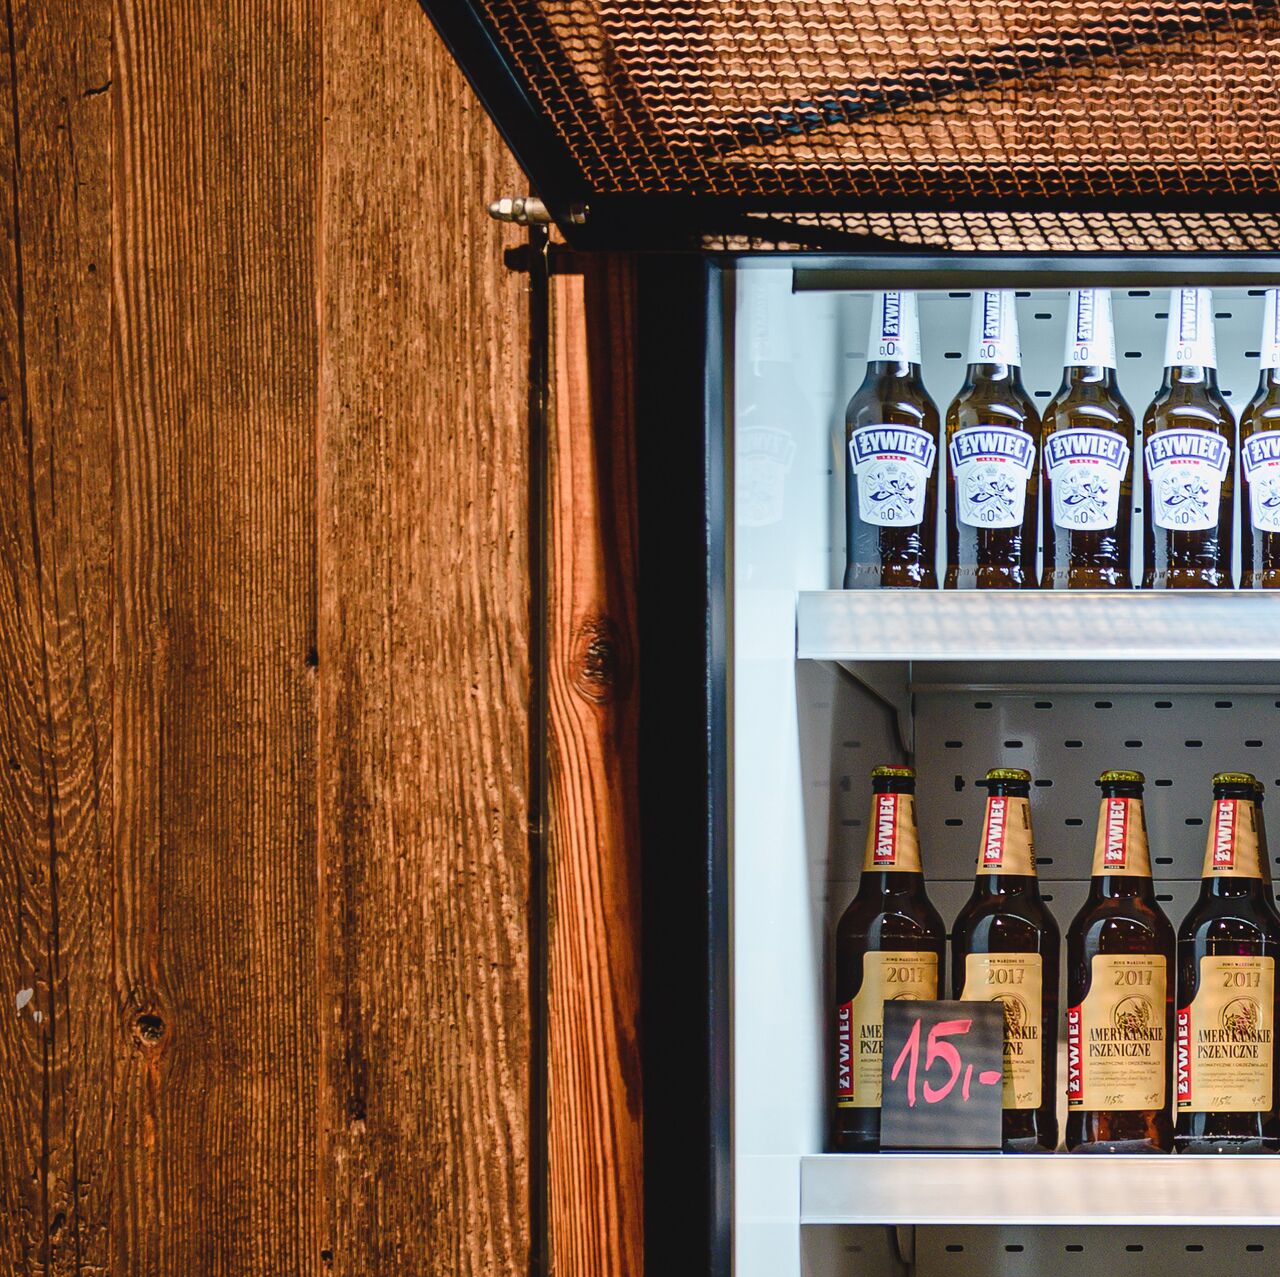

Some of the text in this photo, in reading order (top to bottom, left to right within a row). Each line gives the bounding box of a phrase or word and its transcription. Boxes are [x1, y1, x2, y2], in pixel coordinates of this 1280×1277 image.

[860, 432, 924, 456] ŻYWIEC
[960, 433, 1024, 456] ŻYWIEC
[1153, 436, 1218, 459] ŻYWIEC
[878, 796, 894, 857] ŻYWIEC
[1106, 800, 1125, 861] ŻYWIEC
[1215, 801, 1233, 860] ŻYWIEC
[1114, 970, 1153, 985] 2017
[1223, 972, 1261, 988] 2017
[1089, 1044, 1150, 1056] PSZENICZNE
[1198, 1046, 1258, 1058] PSZENICZNE
